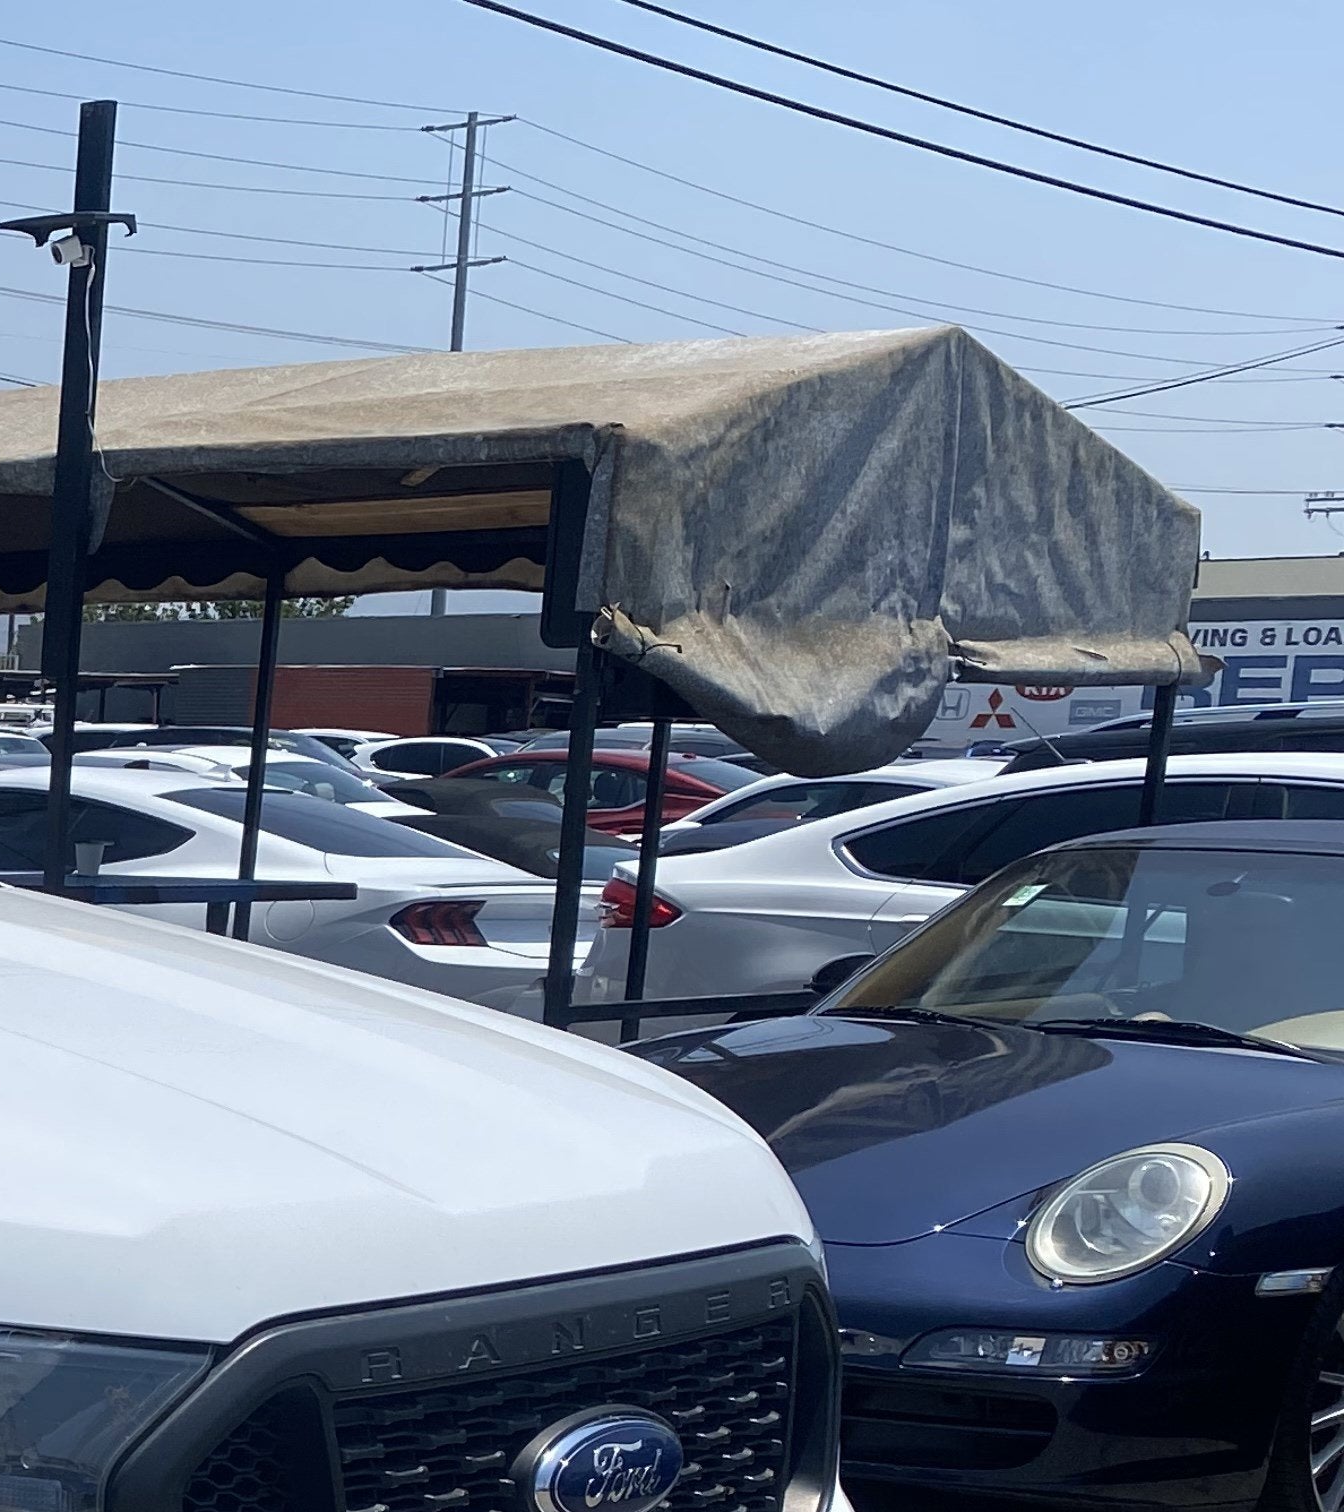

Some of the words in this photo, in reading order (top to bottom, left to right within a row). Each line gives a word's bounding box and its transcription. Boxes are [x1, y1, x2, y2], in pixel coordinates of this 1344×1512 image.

[1259, 627, 1278, 647] &
[360, 1277, 791, 1383] RANGER
[585, 1439, 663, 1508] Ford
